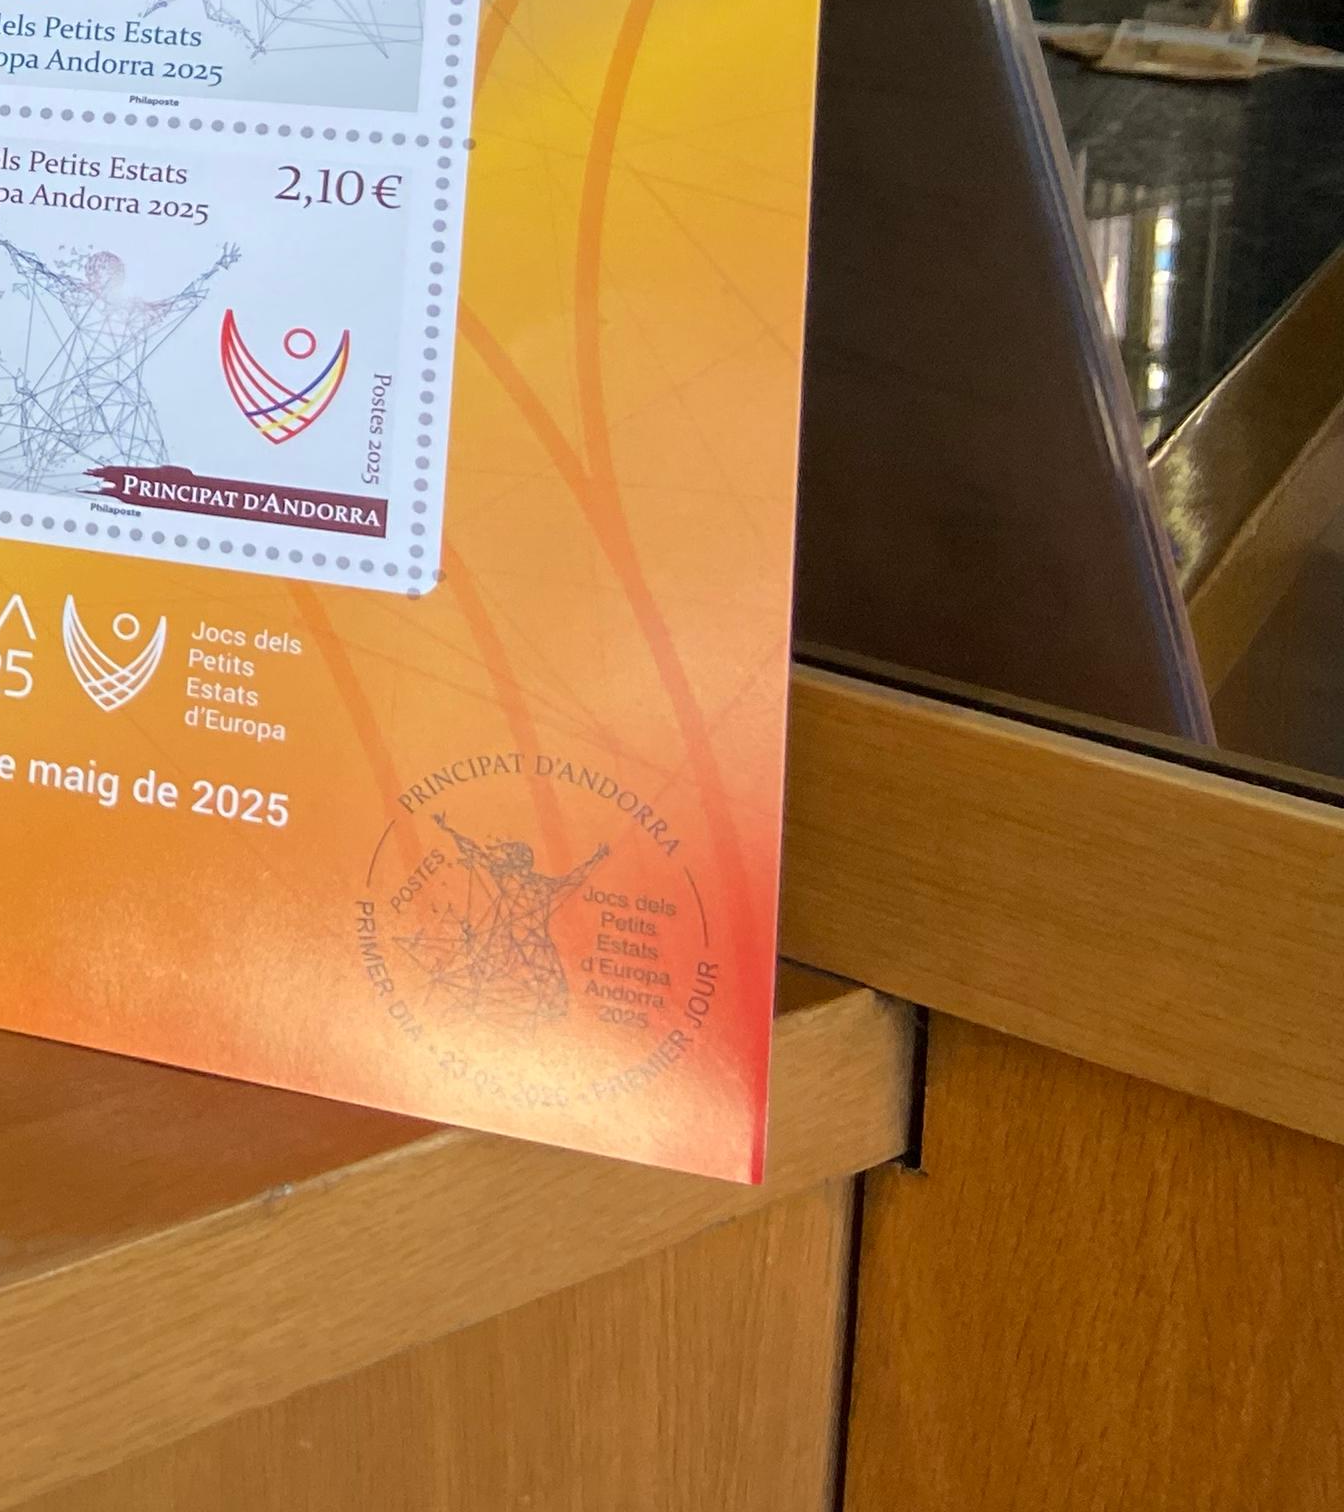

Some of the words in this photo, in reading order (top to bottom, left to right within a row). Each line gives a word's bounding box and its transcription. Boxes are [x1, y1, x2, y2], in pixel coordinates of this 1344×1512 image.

[45, 16, 116, 42] Petits
[124, 21, 202, 47] Estats
[45, 49, 155, 77] Andorra
[162, 60, 223, 86] 2025
[129, 95, 179, 106] Philaposte
[28, 151, 101, 178] Petits
[109, 156, 188, 185] Estats
[29, 183, 140, 214] Andorra
[147, 199, 209, 226] 2025
[369, 373, 392, 434] Postes
[361, 440, 381, 484] 2025
[123, 473, 238, 508] PRINCIPAT
[90, 501, 142, 517] Philaposte
[191, 621, 246, 645] Jocs
[254, 628, 302, 655] dels
[188, 648, 255, 678] Petits
[186, 677, 259, 706] Estats
[184, 705, 286, 742] d'Europa
[29, 760, 119, 808] maig
[132, 769, 178, 808] de
[191, 780, 289, 828] 2025
[397, 753, 525, 814] PRINCIPAT
[536, 755, 681, 857] D'ANDORRA
[390, 848, 446, 914] POSTES
[583, 886, 630, 909] Jocs
[636, 895, 677, 918] dels
[600, 912, 656, 935] Petits
[355, 901, 395, 997] PRIMER
[596, 935, 659, 960] Estats
[581, 957, 671, 987] d'Europa
[585, 980, 664, 1009] Andorra
[684, 961, 719, 1027] JOUR
[600, 1006, 649, 1029] 2025
